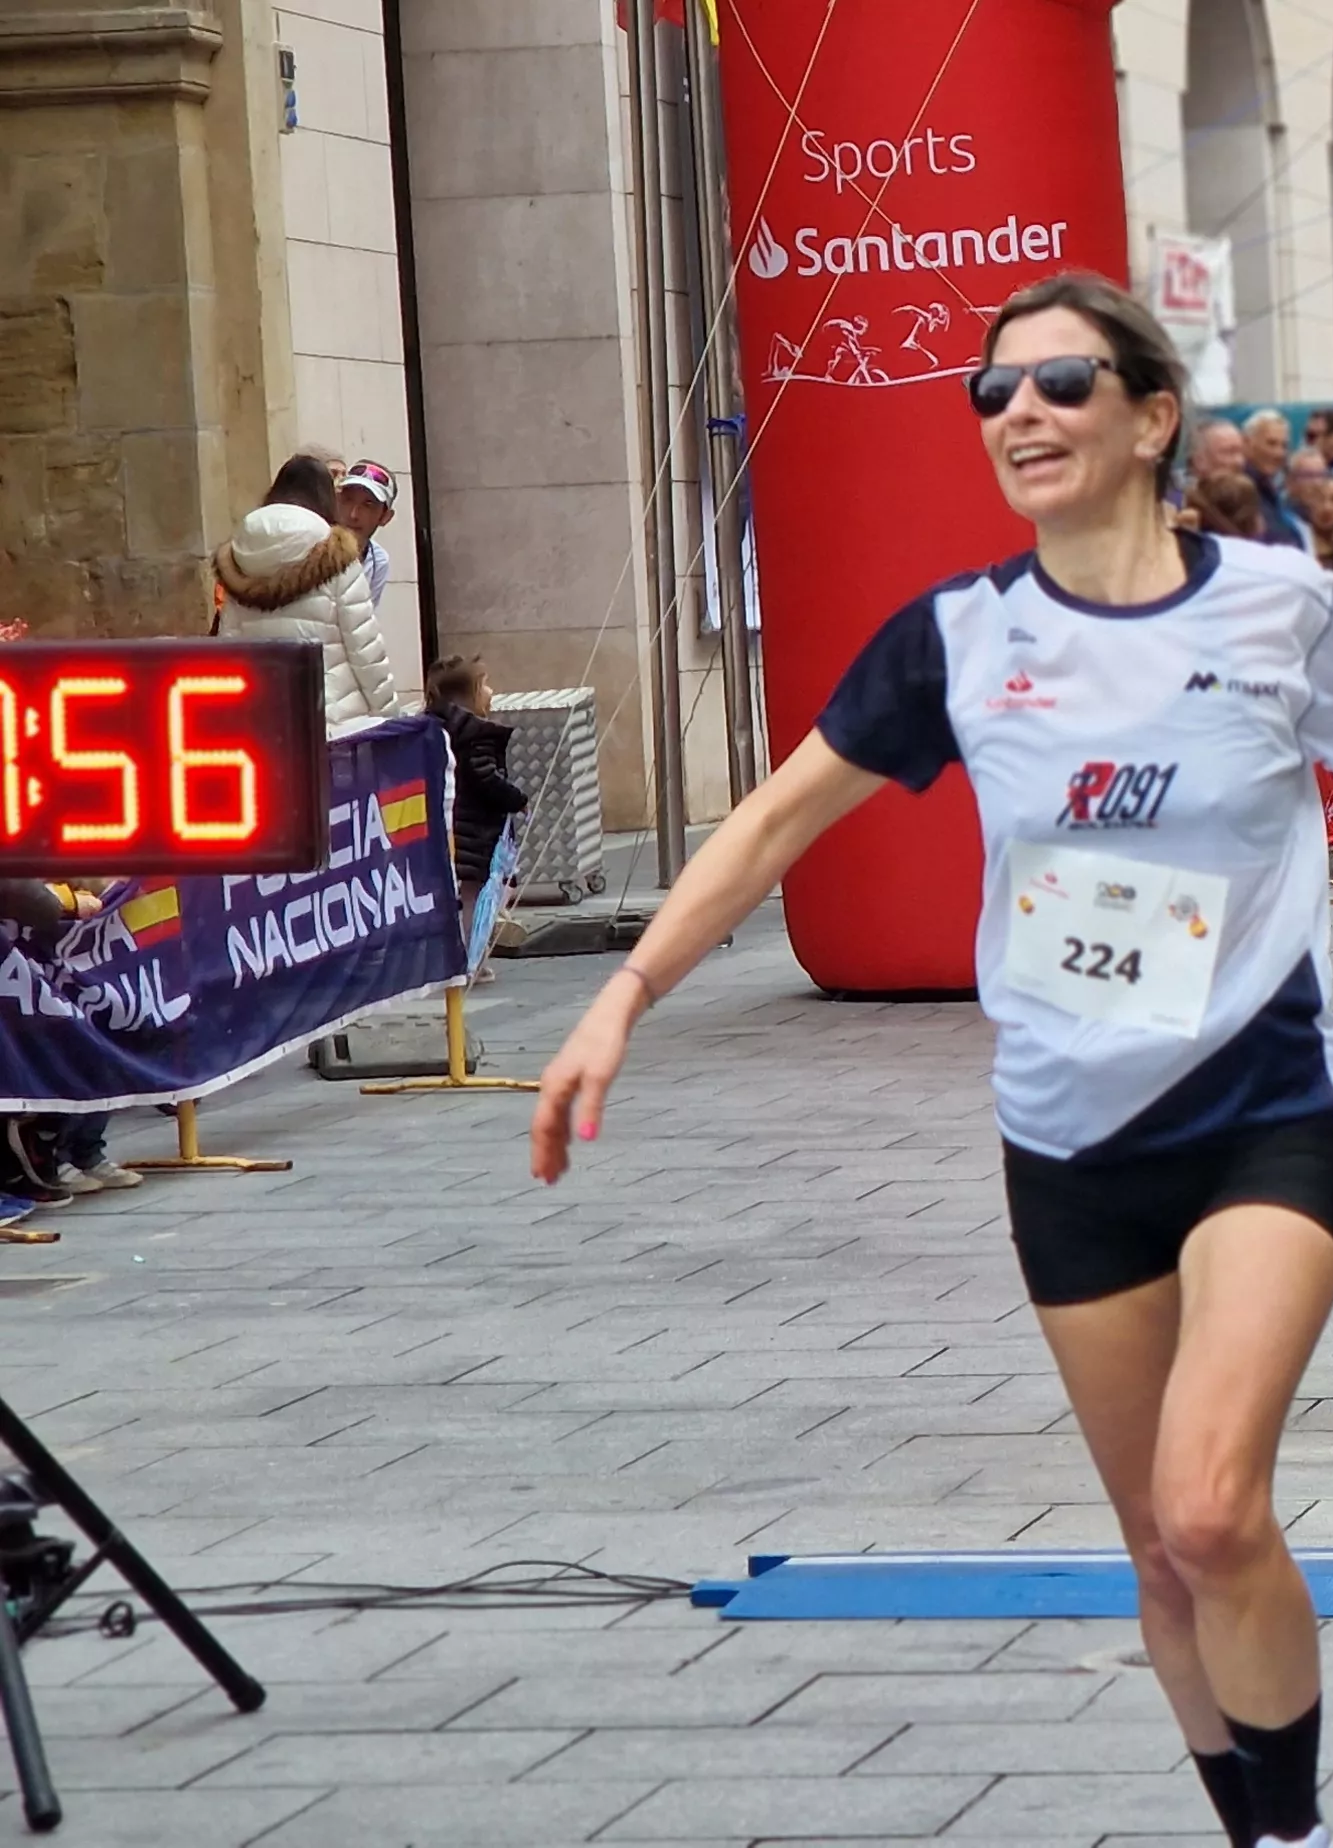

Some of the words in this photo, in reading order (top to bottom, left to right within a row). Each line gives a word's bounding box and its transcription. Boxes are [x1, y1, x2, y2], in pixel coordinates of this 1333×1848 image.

[801, 129, 976, 193] Sports
[795, 215, 1067, 277] Santander
[226, 856, 435, 990] NACIONAL
[1061, 936, 1143, 986] 224
